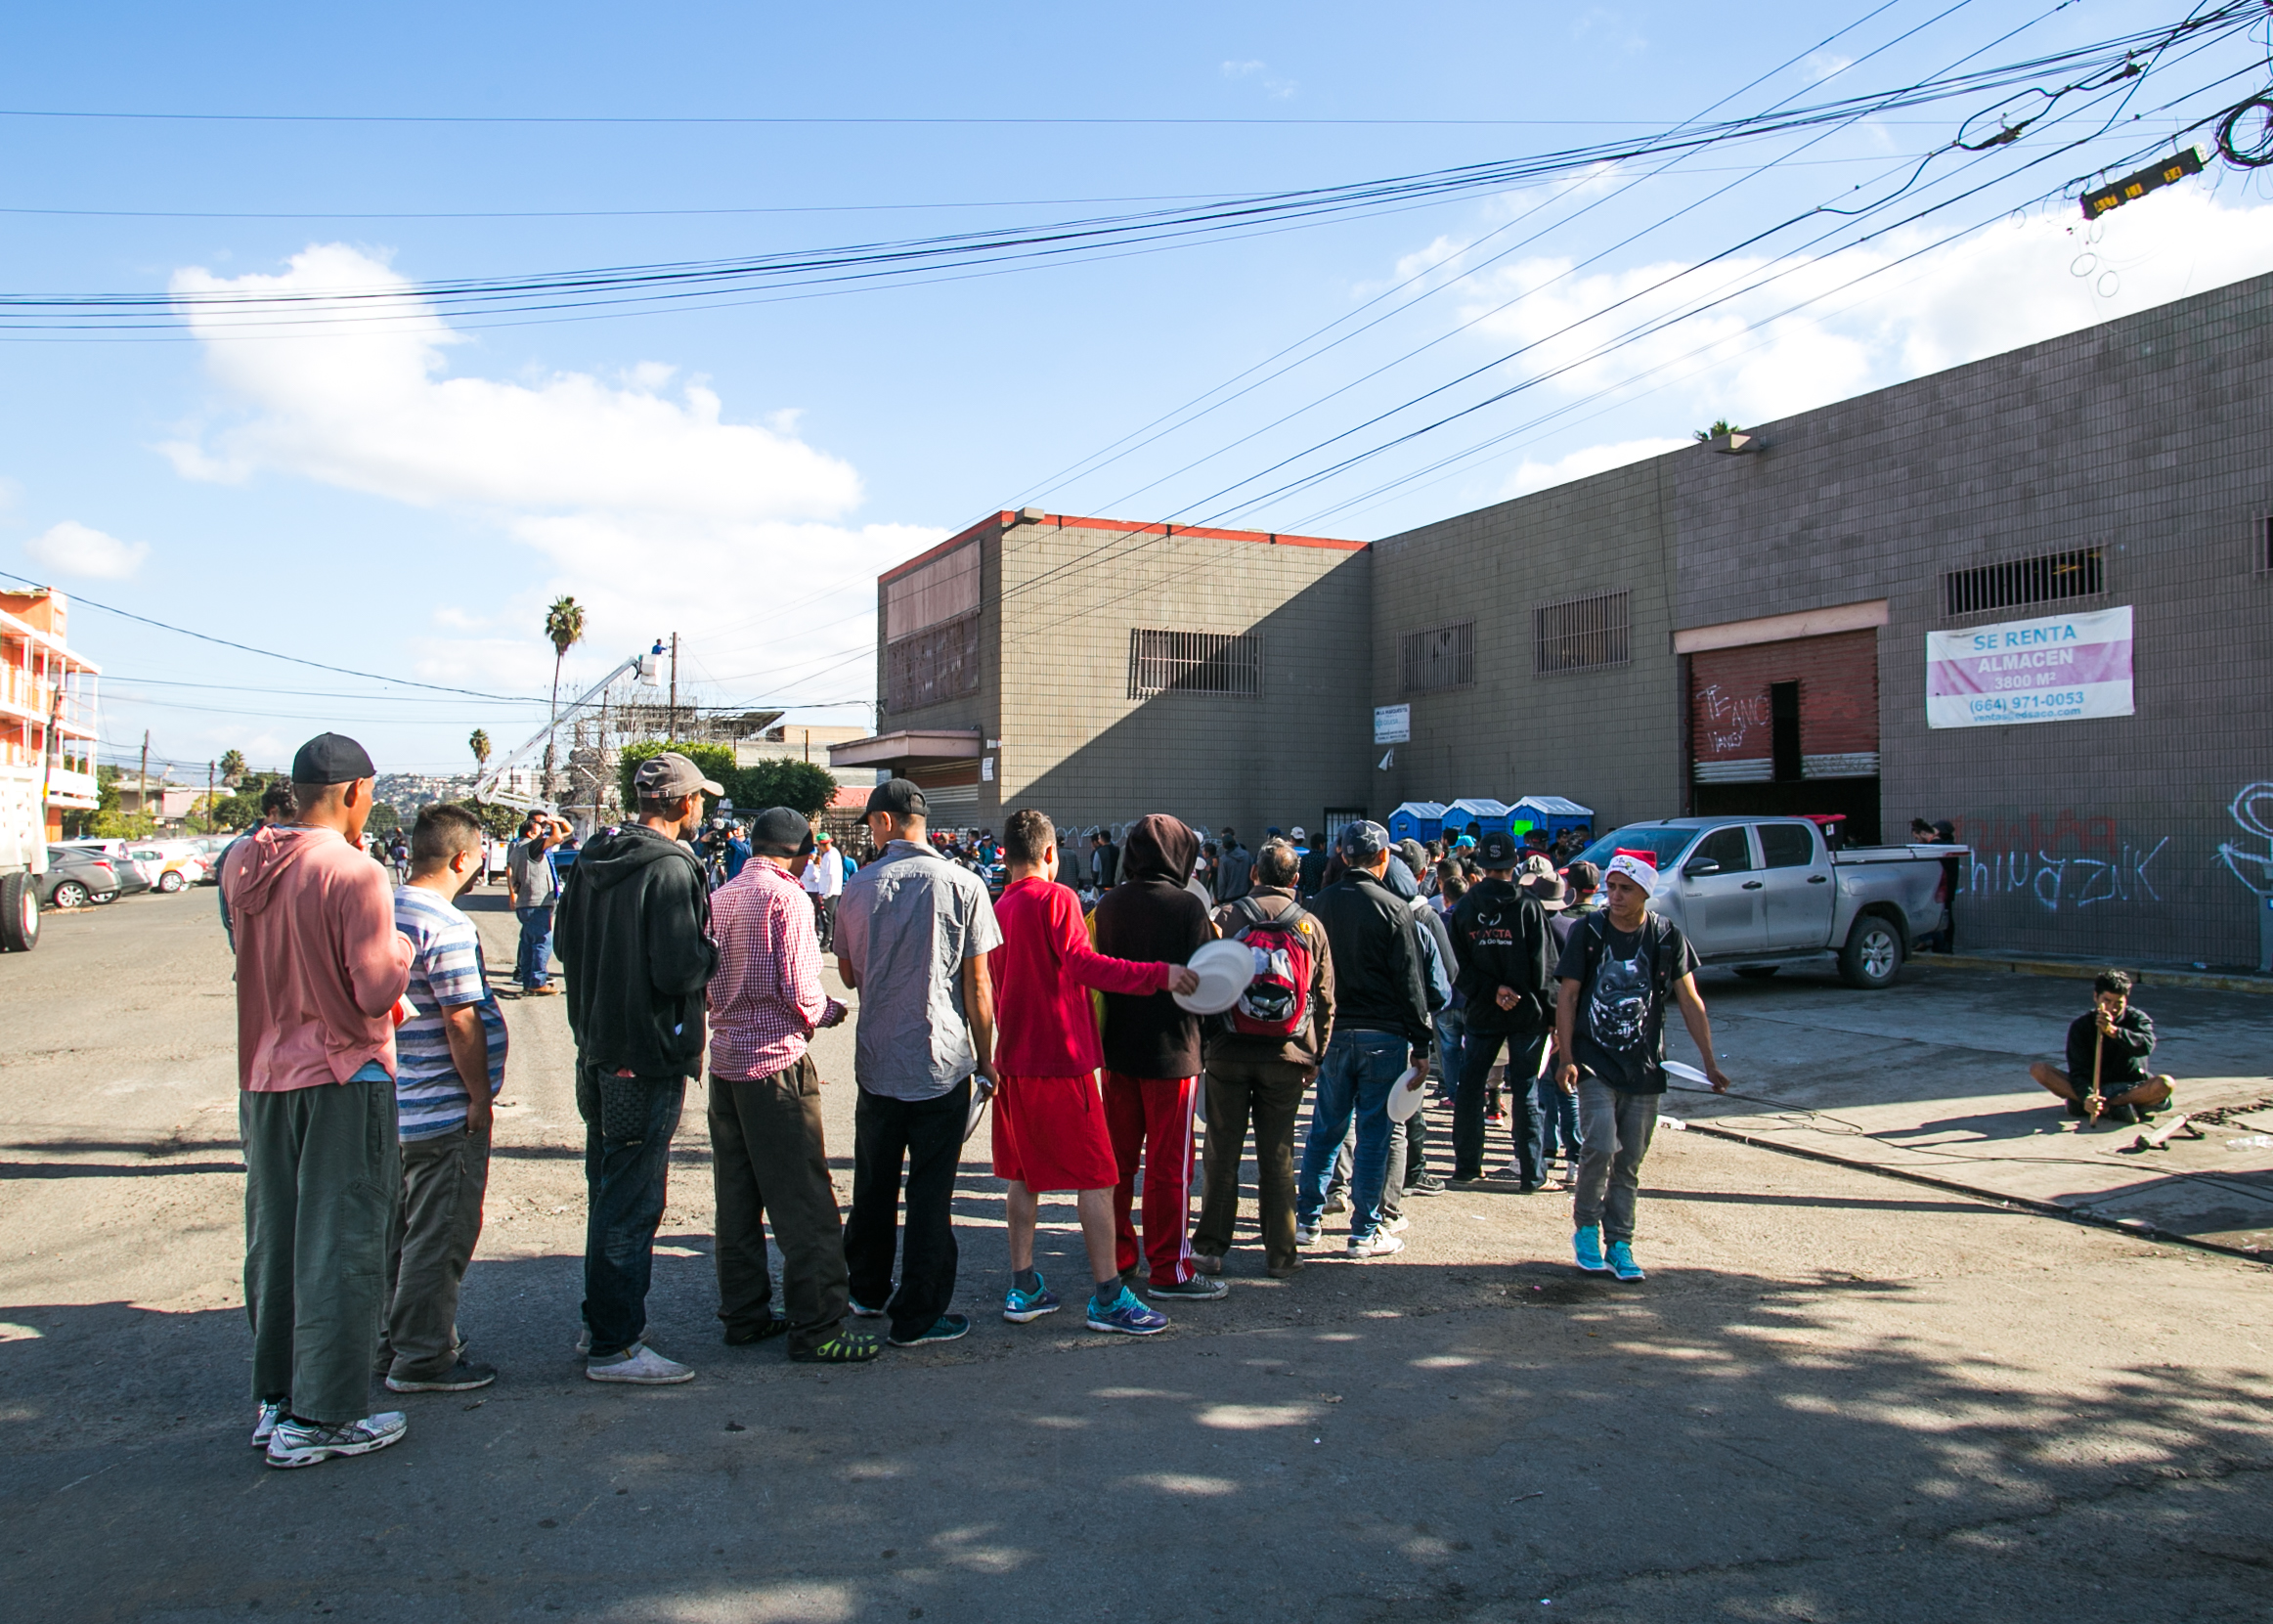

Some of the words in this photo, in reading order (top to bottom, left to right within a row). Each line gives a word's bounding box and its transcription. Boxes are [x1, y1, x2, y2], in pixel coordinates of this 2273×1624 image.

[1973, 634, 1998, 651] SE
[2005, 624, 2077, 647] RENTA
[1978, 647, 2074, 674] ALMACEN
[1994, 675, 2032, 690] 3800
[1696, 684, 1730, 721] TE
[1970, 697, 2007, 715] (664)
[2012, 691, 2084, 710] 971-0053
